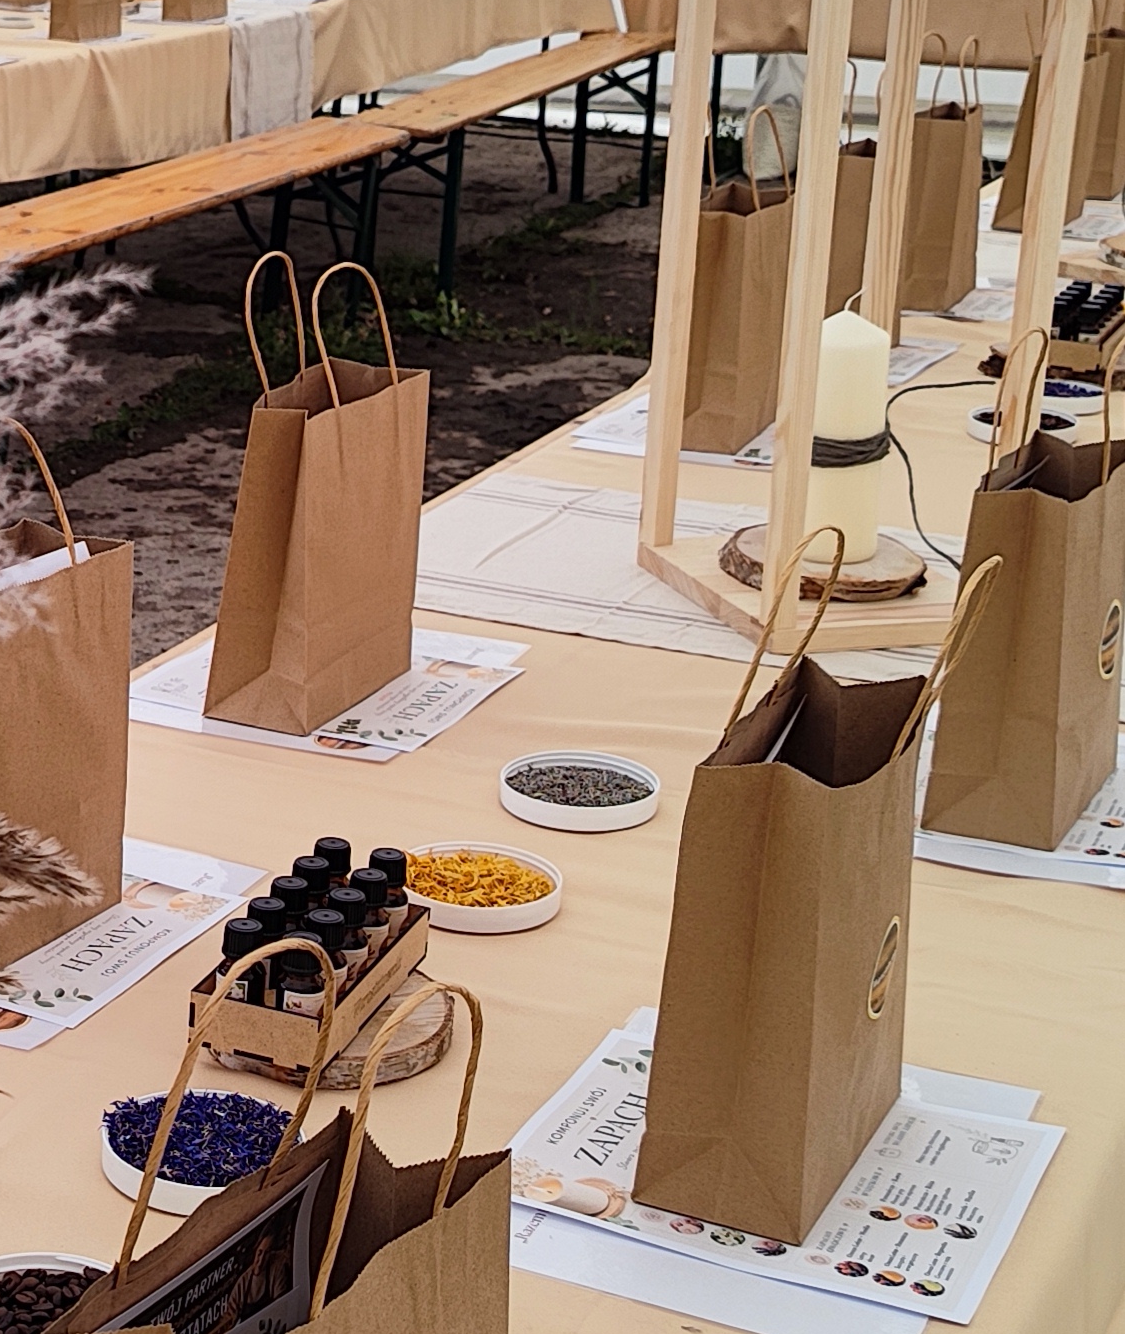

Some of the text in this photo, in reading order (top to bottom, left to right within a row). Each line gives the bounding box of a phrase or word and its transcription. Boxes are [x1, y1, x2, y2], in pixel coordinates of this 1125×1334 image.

[392, 681, 459, 721] ZAPACH
[60, 916, 154, 973] ZAPACH
[125, 928, 173, 960] KOMPONUJ
[546, 1086, 608, 1145] KOMPONUJ SWÓJ
[574, 1092, 648, 1166] ZAPACH
